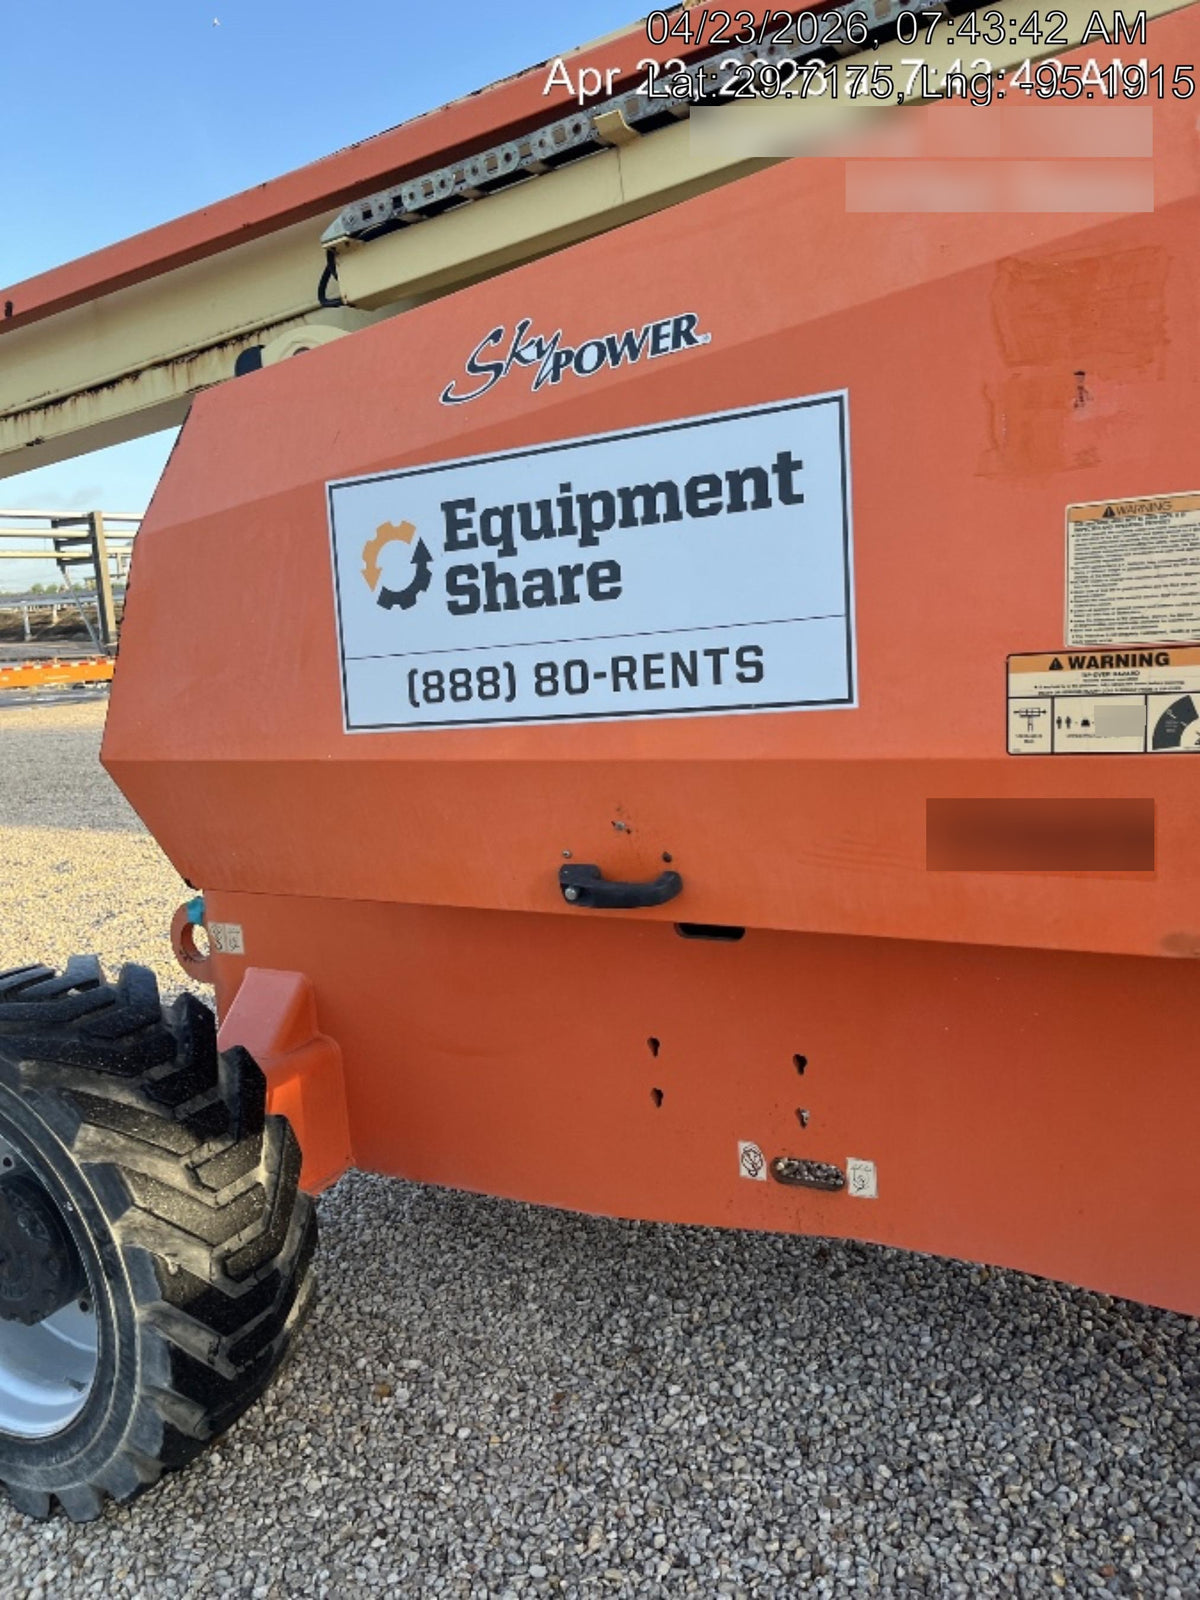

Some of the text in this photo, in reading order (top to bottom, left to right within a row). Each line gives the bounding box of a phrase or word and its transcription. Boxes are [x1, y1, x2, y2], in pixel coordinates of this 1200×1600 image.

[440, 450, 804, 558] Equipment
[1116, 501, 1173, 515] WARNING
[446, 559, 622, 616] Share
[407, 645, 765, 707] (888) 80-RENTS
[1068, 652, 1170, 669] WARNING
